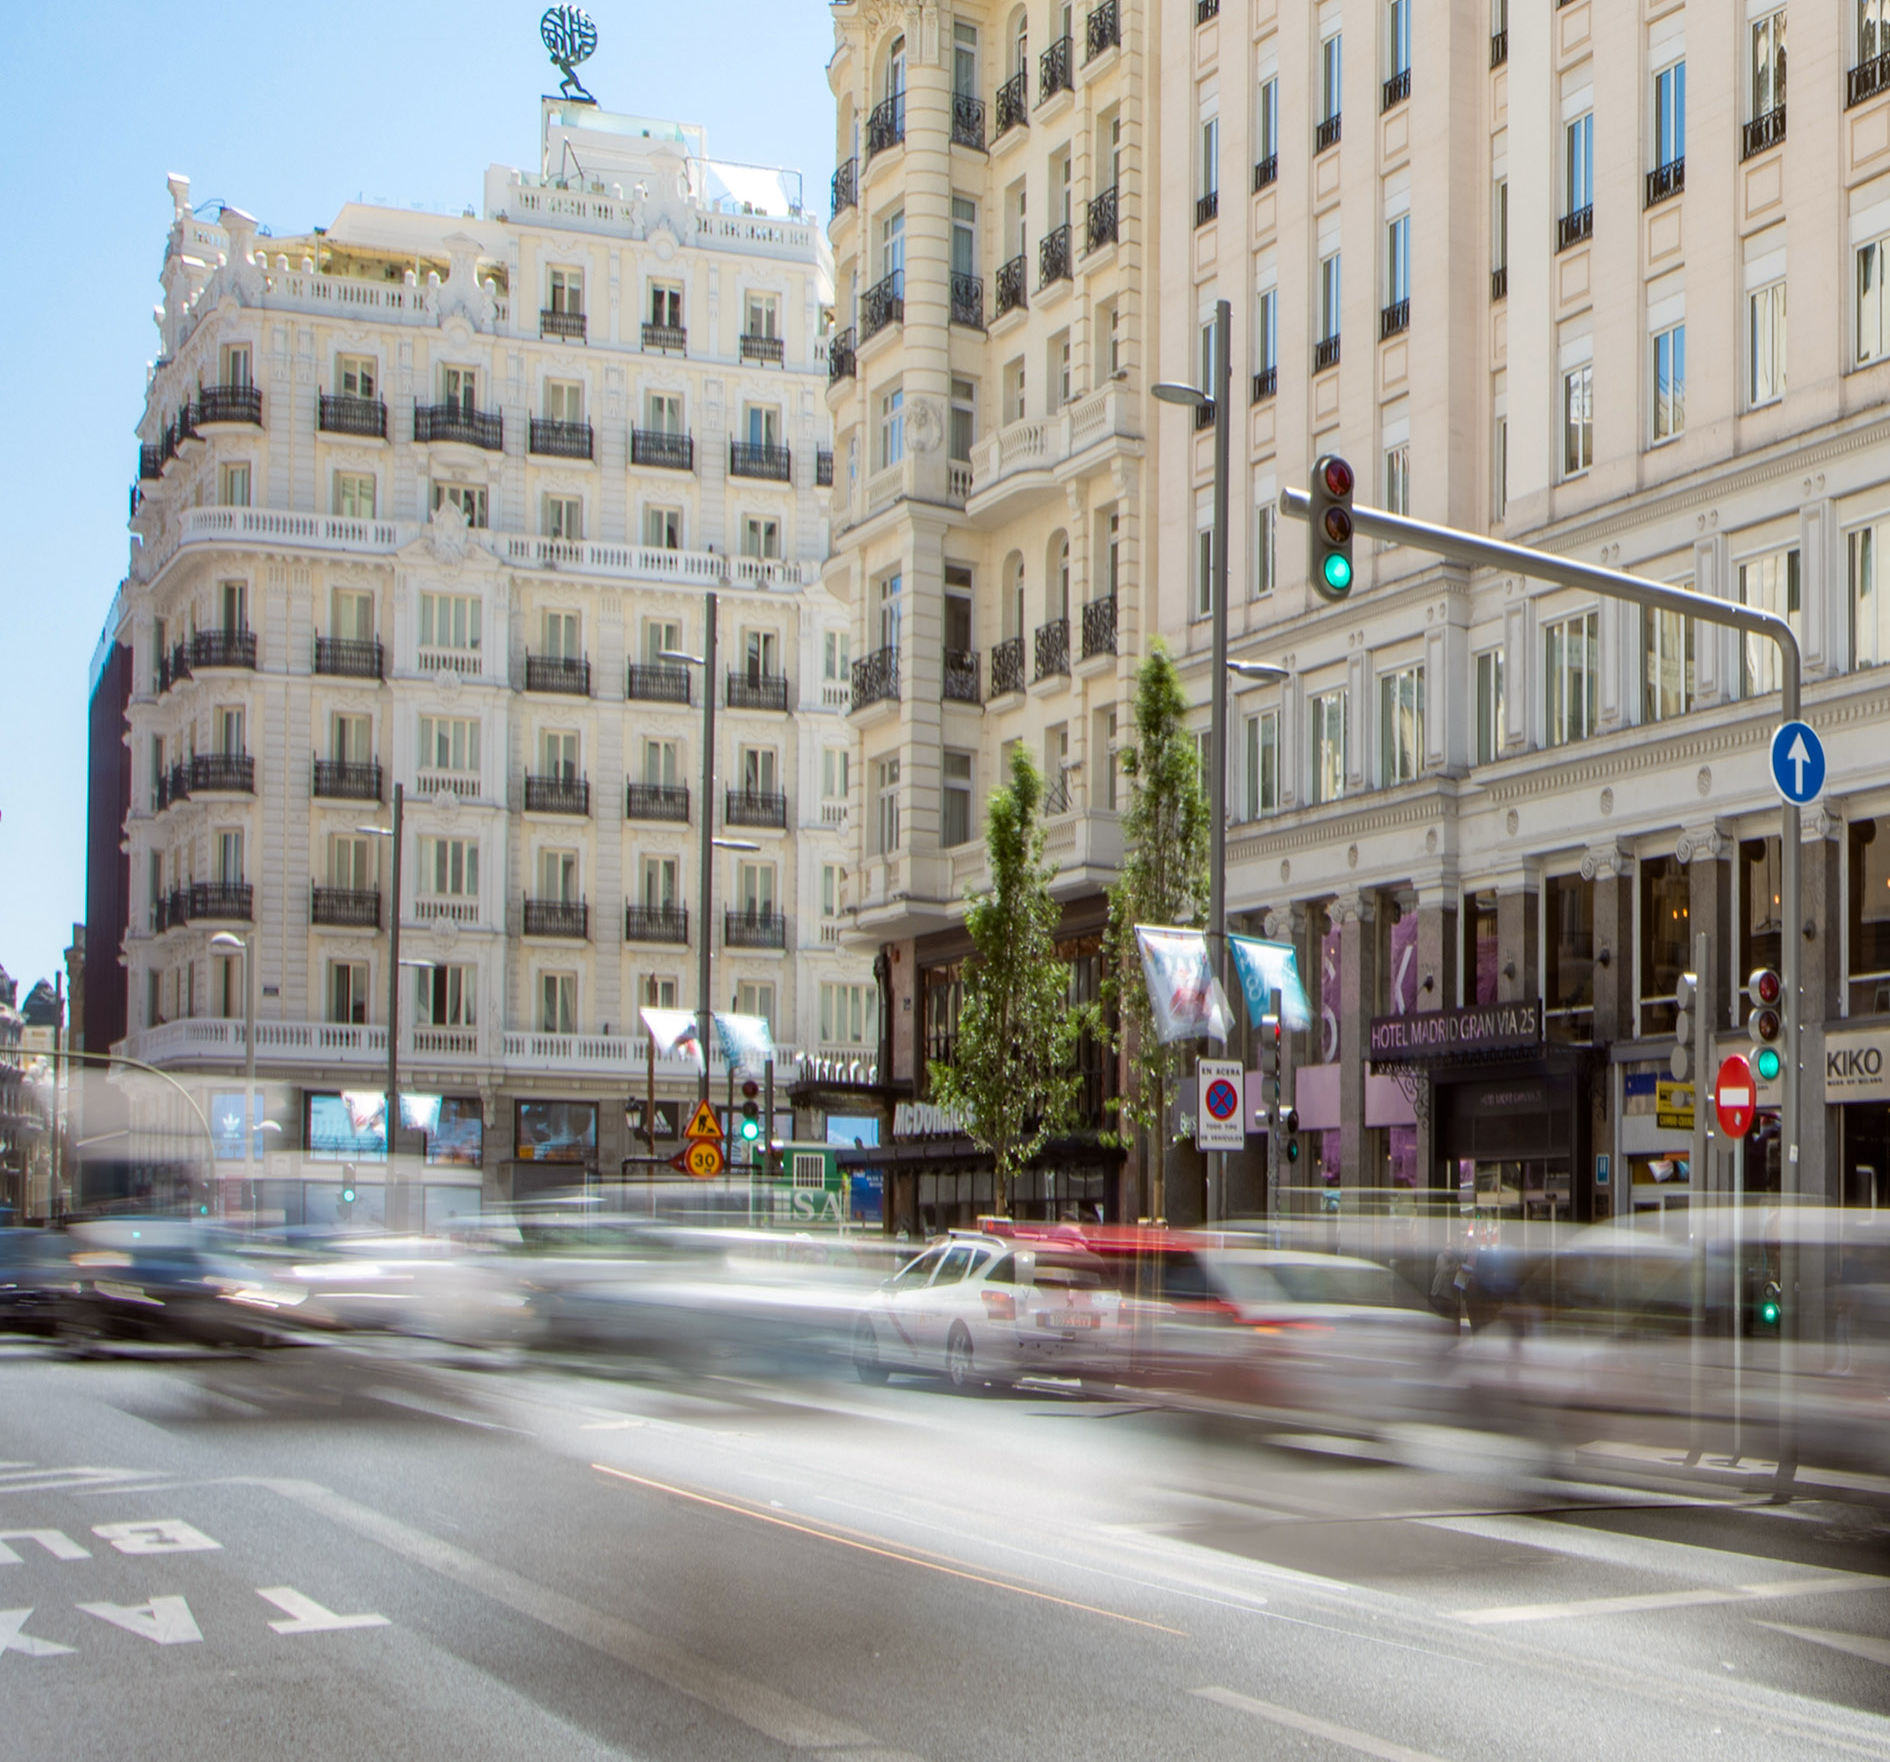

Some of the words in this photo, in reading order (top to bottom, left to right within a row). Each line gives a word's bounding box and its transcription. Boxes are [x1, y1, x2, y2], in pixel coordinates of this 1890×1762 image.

[1371, 1024, 1408, 1049] HOTEL
[1411, 1015, 1459, 1044] MADRID
[1460, 1011, 1495, 1039] GRAN
[1497, 1006, 1518, 1036] VÍA
[1519, 1006, 1536, 1035] 25
[1202, 1066, 1212, 1075] EN
[1216, 1067, 1240, 1076] ACERA
[1826, 1047, 1883, 1078] KIKO
[694, 1153, 715, 1168] 30
